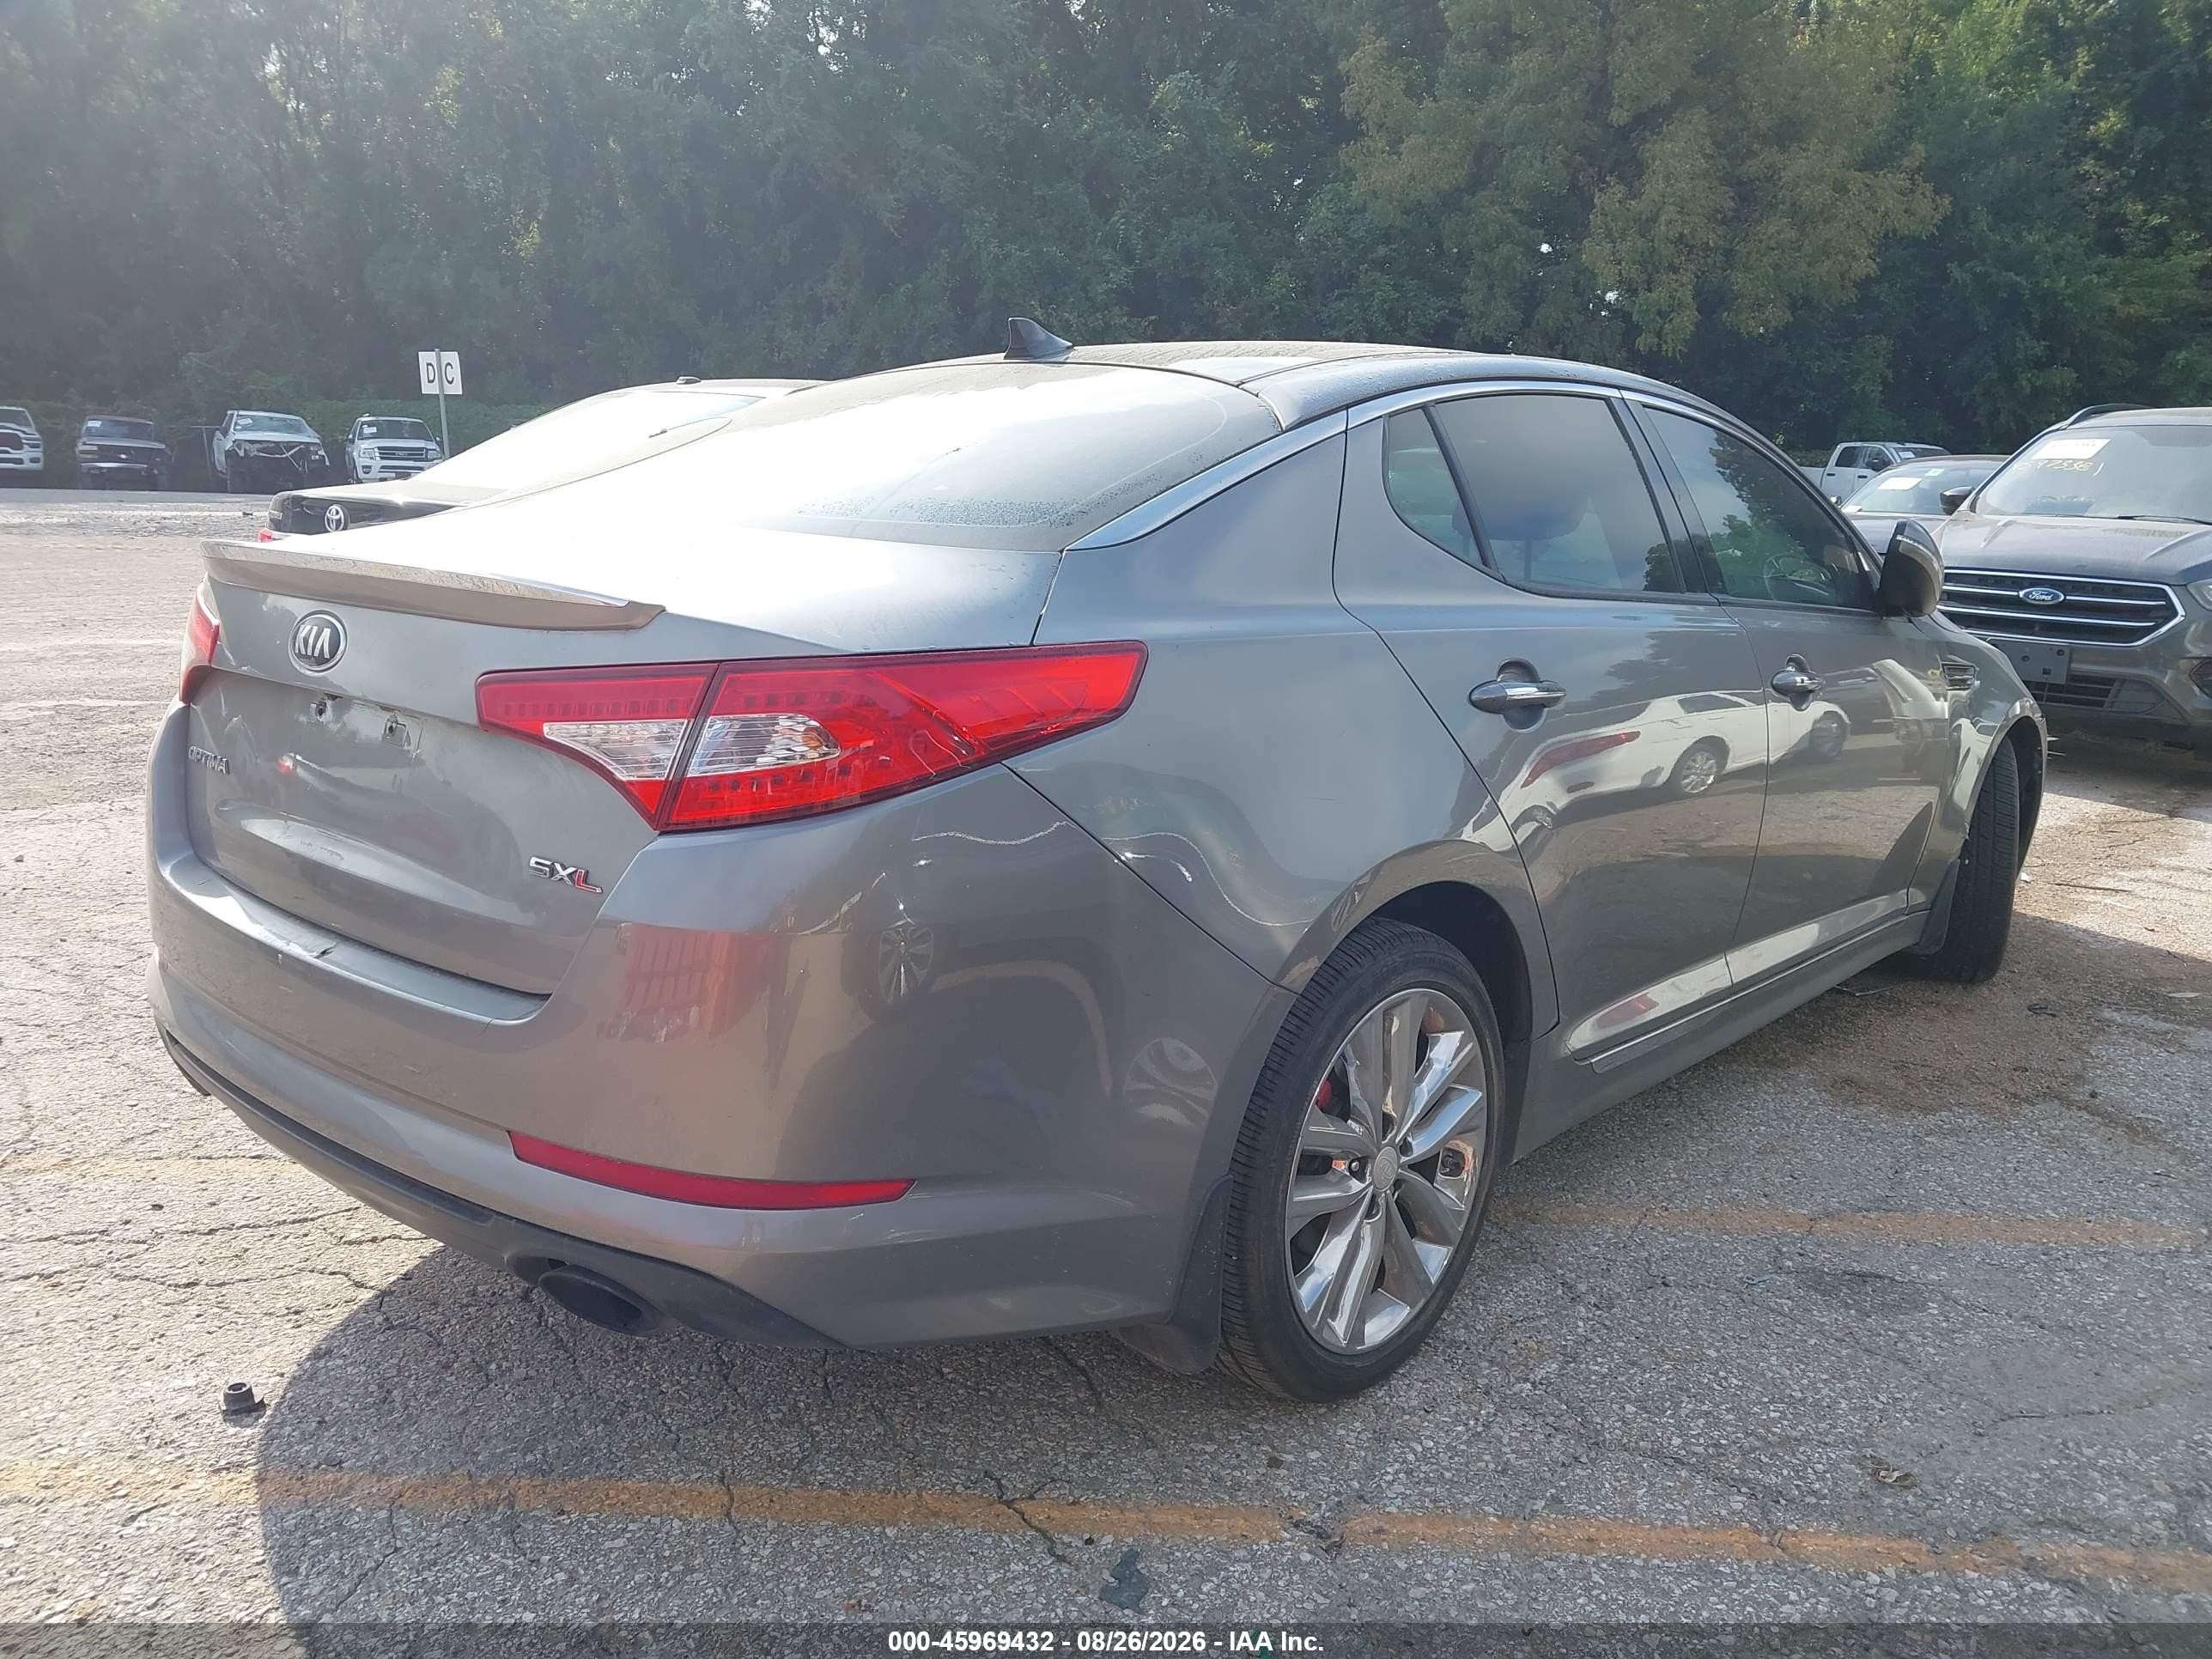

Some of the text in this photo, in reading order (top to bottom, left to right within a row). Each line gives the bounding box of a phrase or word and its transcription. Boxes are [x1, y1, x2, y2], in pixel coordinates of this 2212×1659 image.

[426, 362, 454, 385] D C
[2028, 590, 2055, 601] Ford
[295, 624, 331, 659] KIA
[188, 745, 229, 775] OPTIMA
[529, 856, 604, 893] SXL
